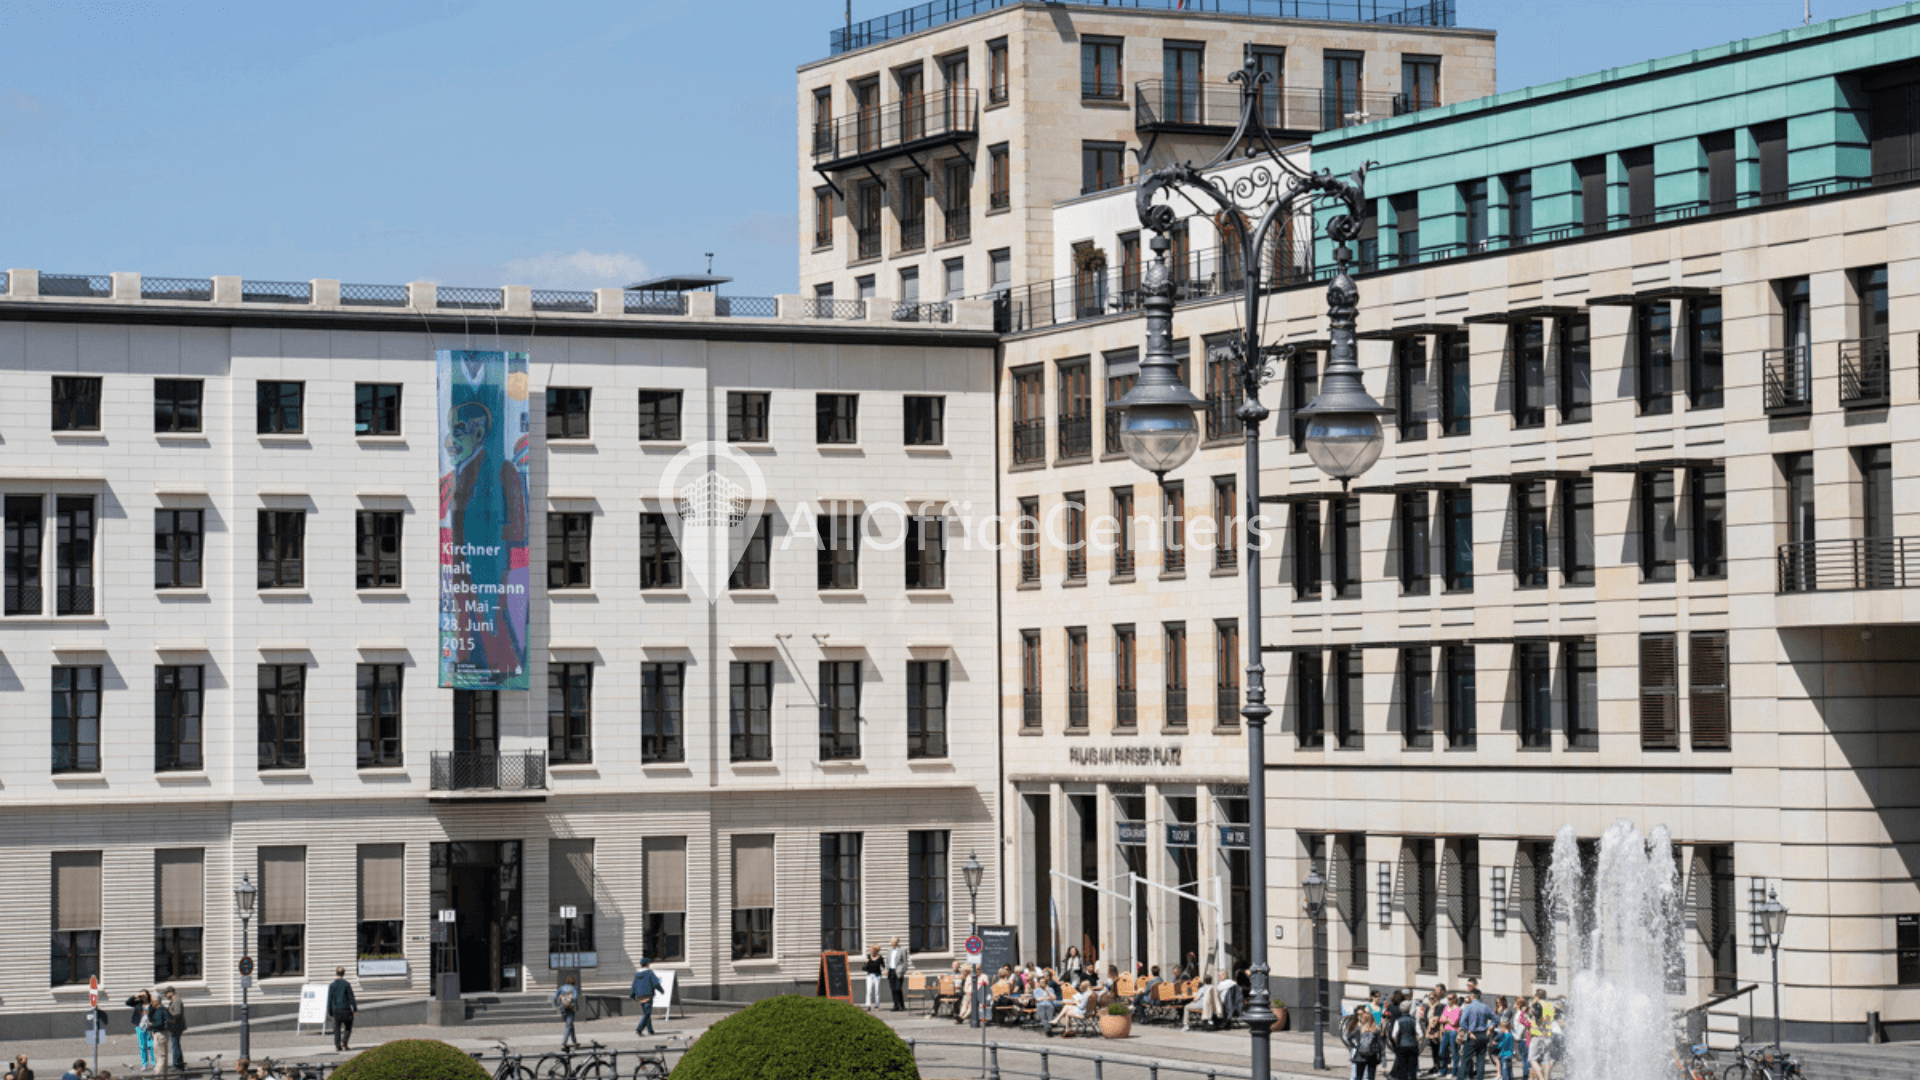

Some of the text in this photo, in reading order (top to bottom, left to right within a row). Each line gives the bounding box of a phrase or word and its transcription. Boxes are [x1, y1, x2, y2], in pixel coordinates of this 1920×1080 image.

[442, 542, 501, 556] Kirchner
[442, 561, 472, 574] malt
[442, 580, 525, 594] Liebermann
[442, 600, 461, 613] 21.
[465, 600, 489, 613] Mai
[442, 618, 494, 632] 28. Juni
[442, 637, 475, 650] 2015
[1070, 747, 1098, 766] PALAIS
[1115, 747, 1153, 766] PARISER
[1153, 746, 1182, 766] PLATZ
